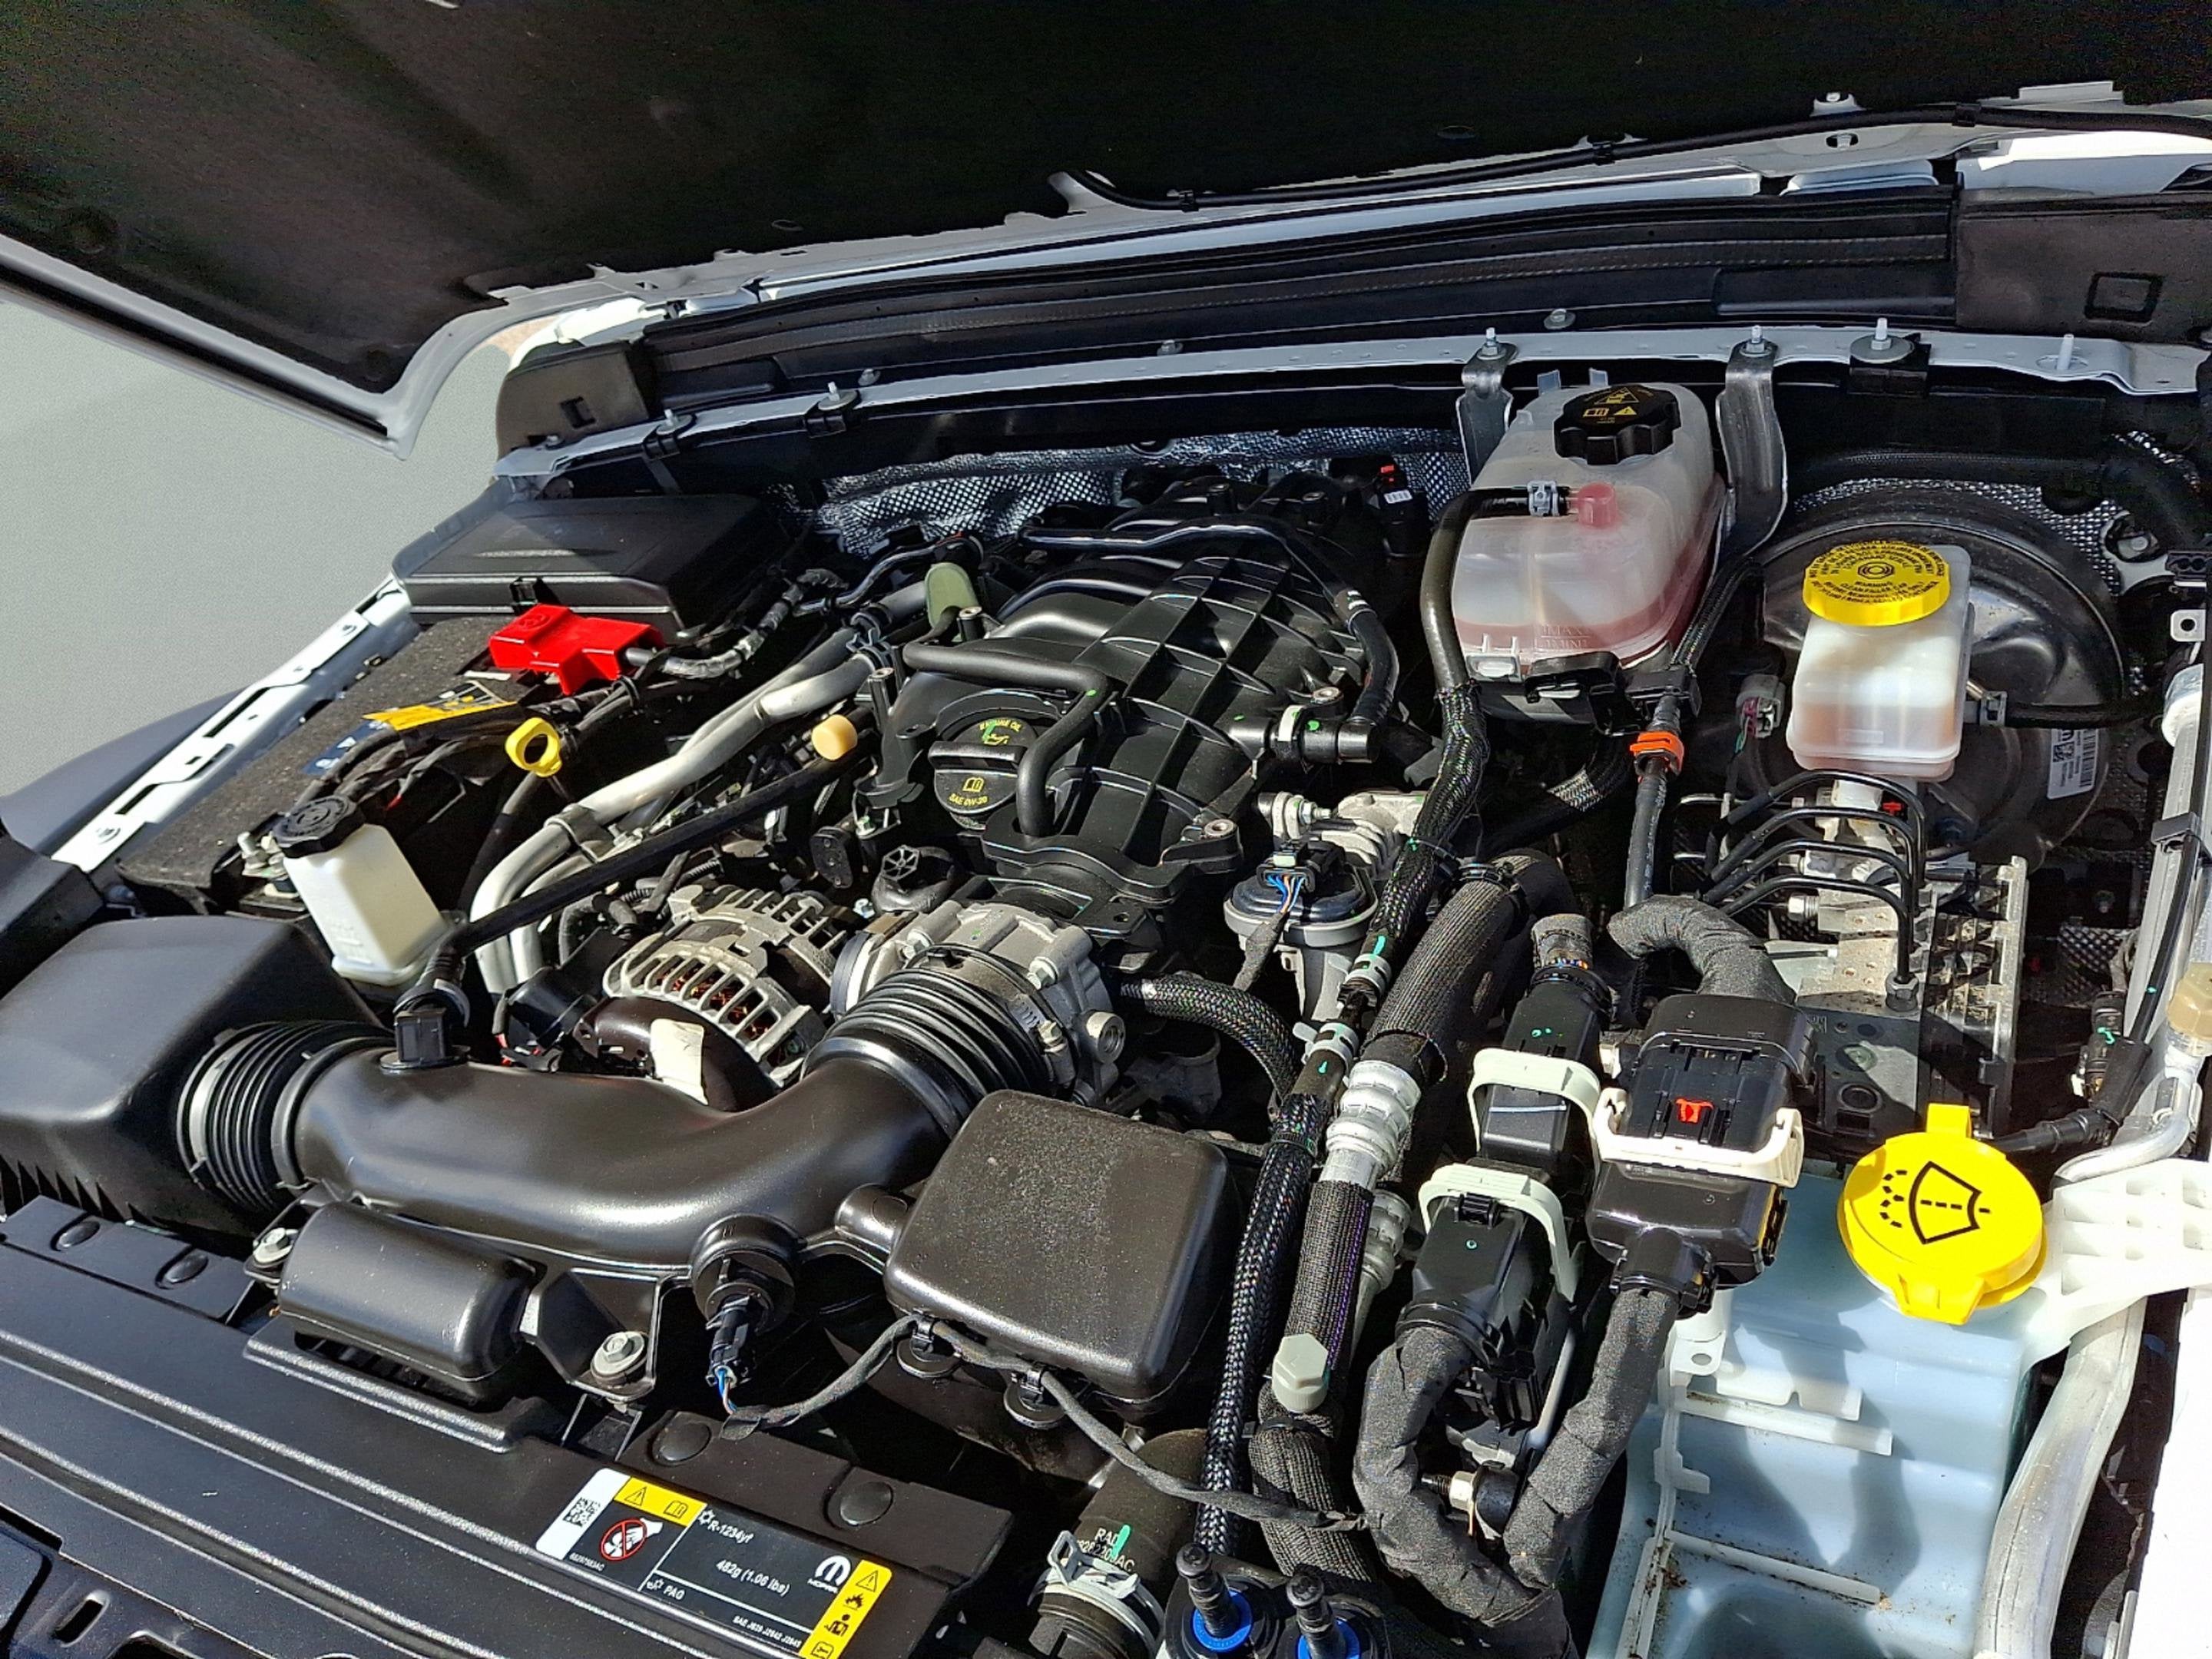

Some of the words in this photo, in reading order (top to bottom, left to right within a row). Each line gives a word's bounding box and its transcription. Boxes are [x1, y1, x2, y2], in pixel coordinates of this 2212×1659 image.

[949, 793, 964, 806] SAE
[716, 1559, 743, 1578] 482g
[740, 1568, 769, 1587] (1.06
[767, 1577, 791, 1597] lbs)
